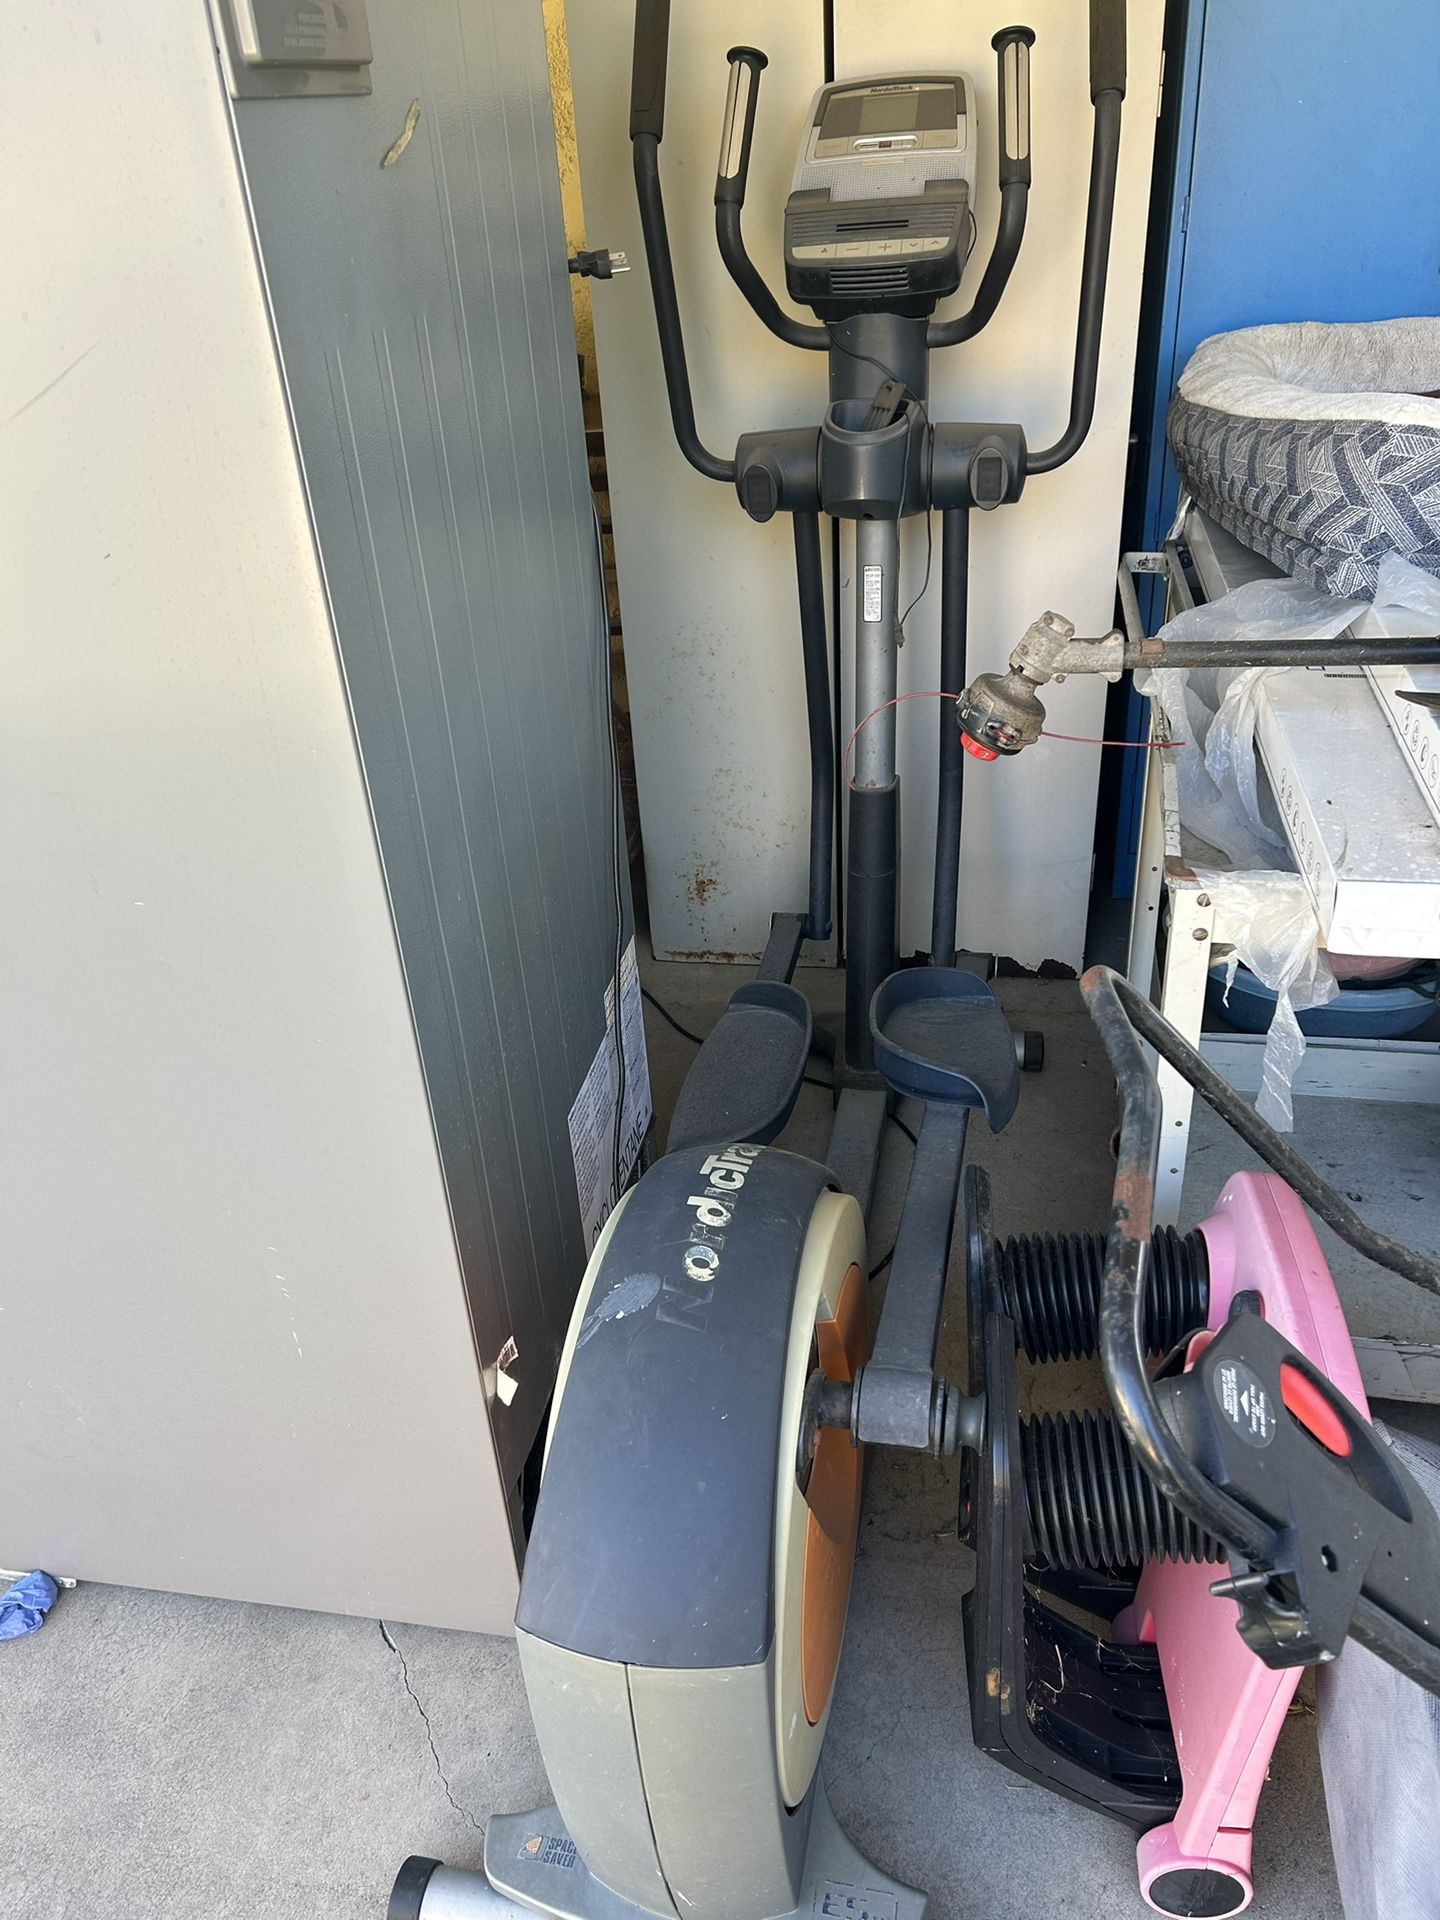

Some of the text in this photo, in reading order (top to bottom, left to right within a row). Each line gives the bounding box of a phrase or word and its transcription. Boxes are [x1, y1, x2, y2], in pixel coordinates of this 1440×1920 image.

[591, 1110, 644, 1248] CYCLOENTANE
[656, 1143, 763, 1332] NordicTra
[542, 1850, 577, 1869] SAVER
